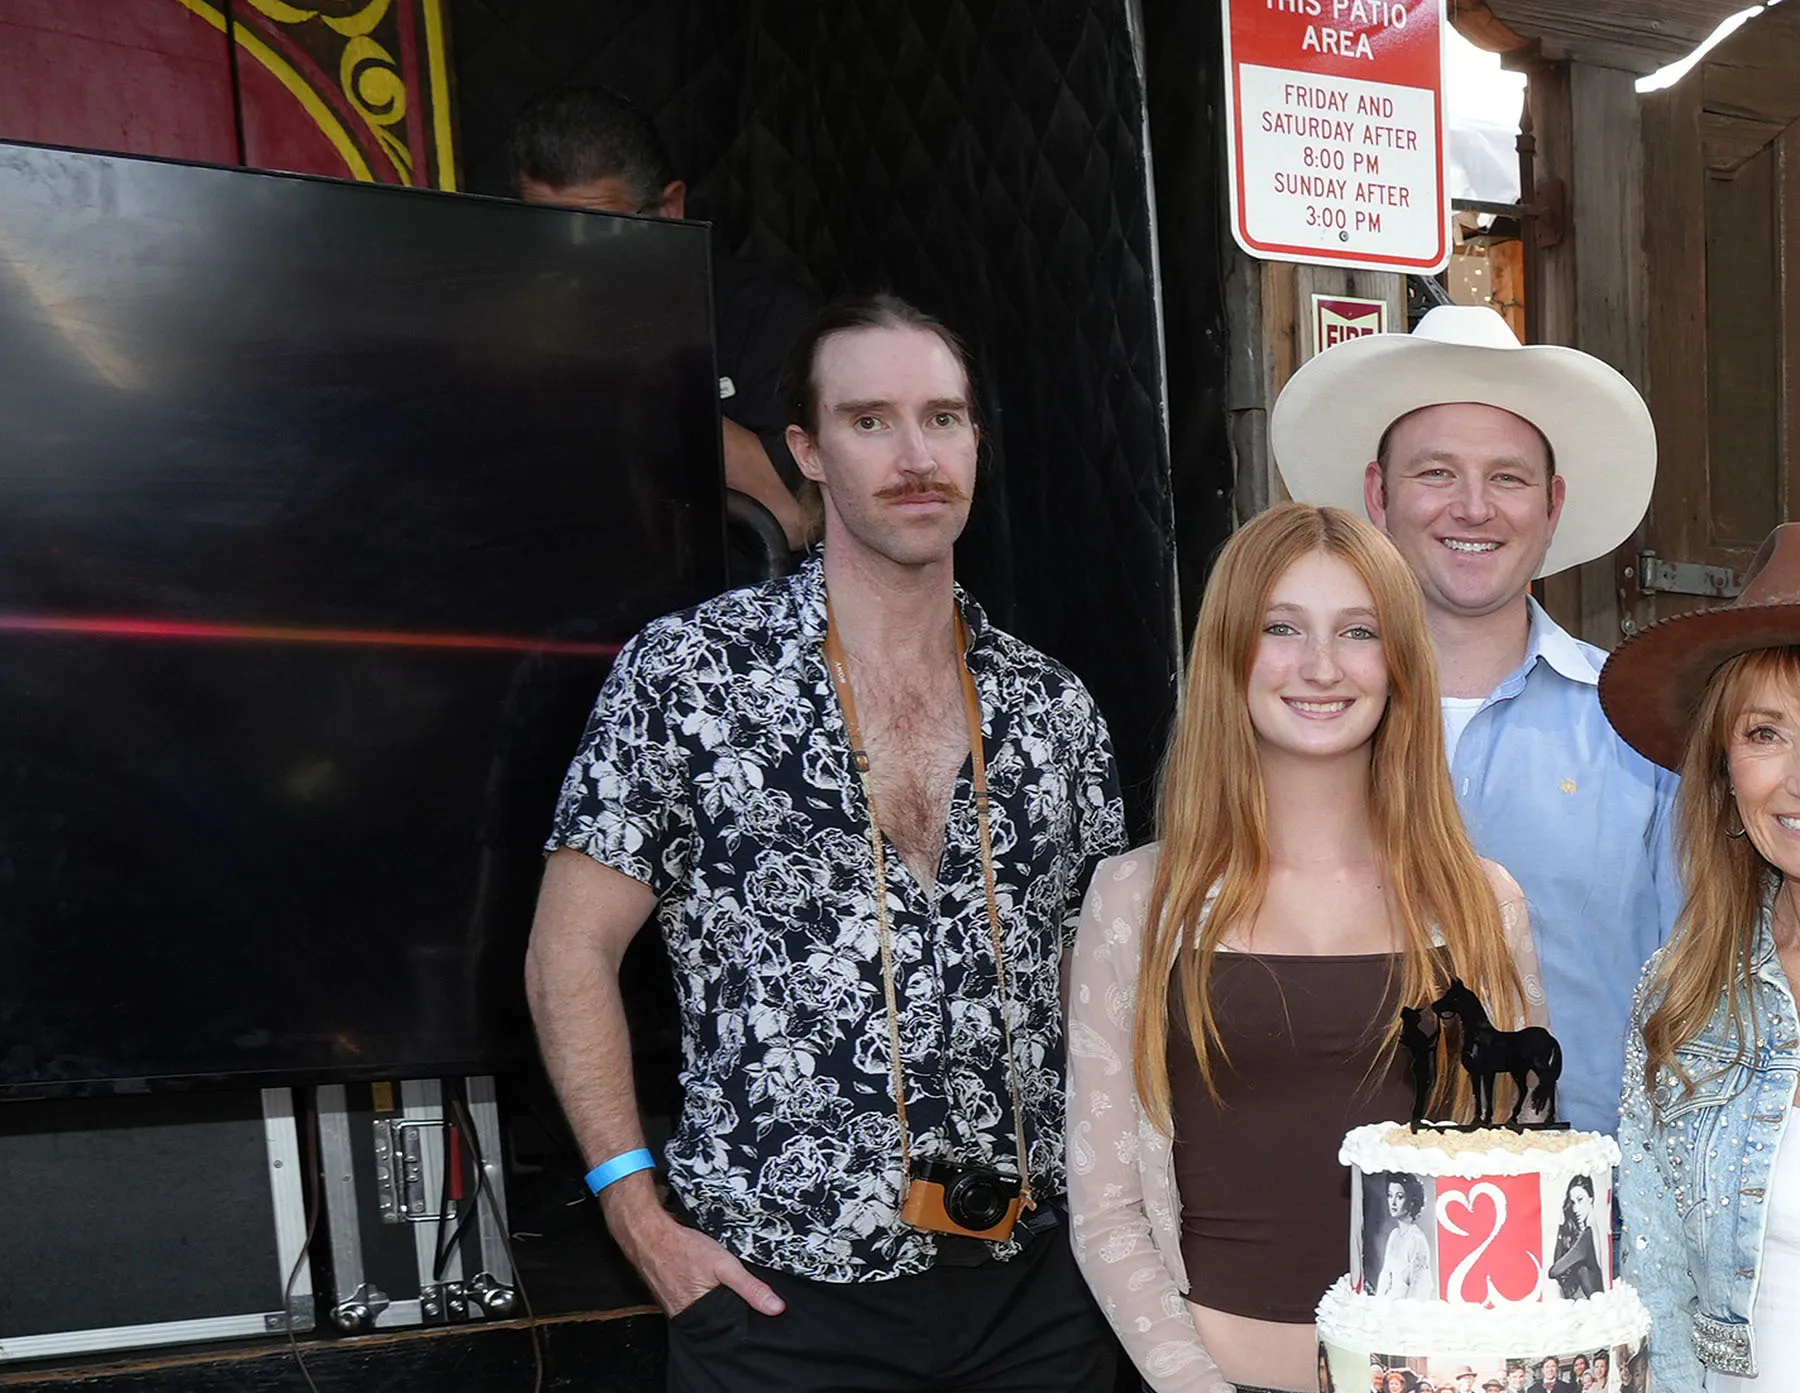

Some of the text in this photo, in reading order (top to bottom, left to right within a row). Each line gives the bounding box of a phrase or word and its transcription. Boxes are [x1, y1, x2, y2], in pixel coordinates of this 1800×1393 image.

[1333, 0, 1408, 29] PATIO
[1301, 25, 1375, 60] AREA
[1284, 84, 1394, 118] FRIDAY AND
[1262, 111, 1418, 151] SATURDAY AFTER
[1303, 146, 1379, 175] 8:00 PM
[1274, 172, 1410, 207] SUNDAY AFTER
[1306, 205, 1382, 233] 3:00 PM
